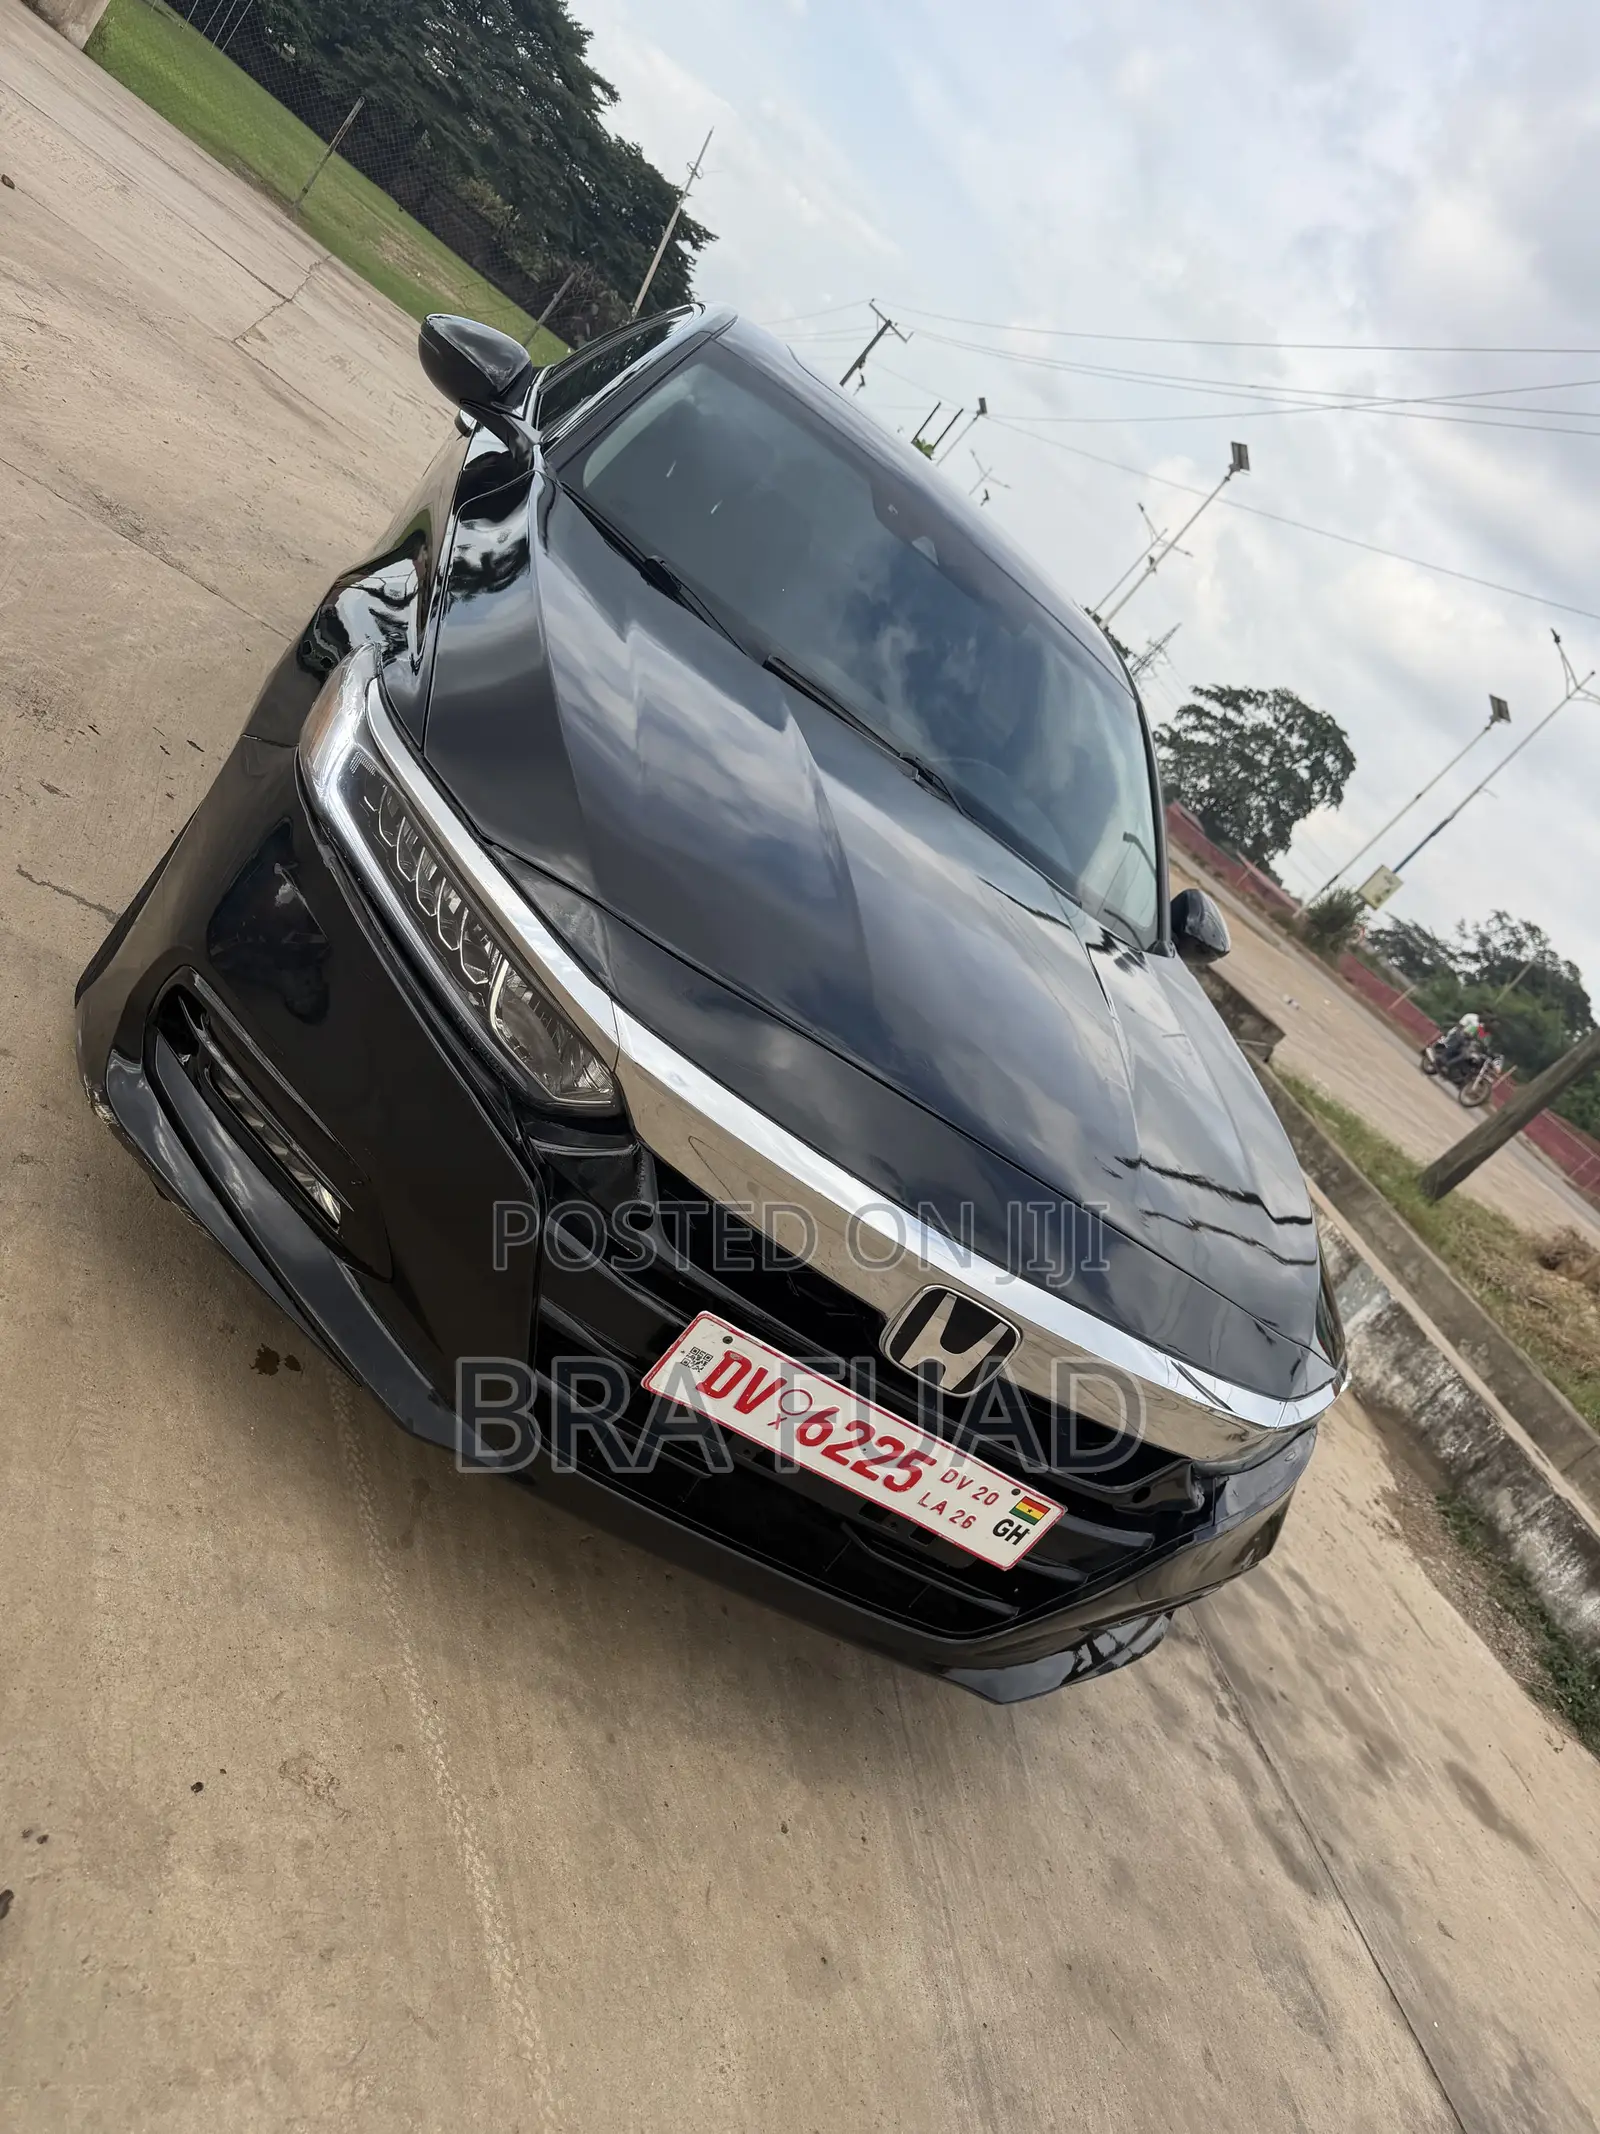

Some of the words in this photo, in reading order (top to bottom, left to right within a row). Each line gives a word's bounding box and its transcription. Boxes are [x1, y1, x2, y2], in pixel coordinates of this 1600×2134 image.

[695, 1349, 786, 1415] DV
[796, 1404, 937, 1493] 6225
[939, 1467, 975, 1490] DV
[977, 1485, 1000, 1506] 20
[917, 1490, 947, 1516] LA
[948, 1507, 978, 1530] 26
[992, 1518, 1031, 1546] GH
